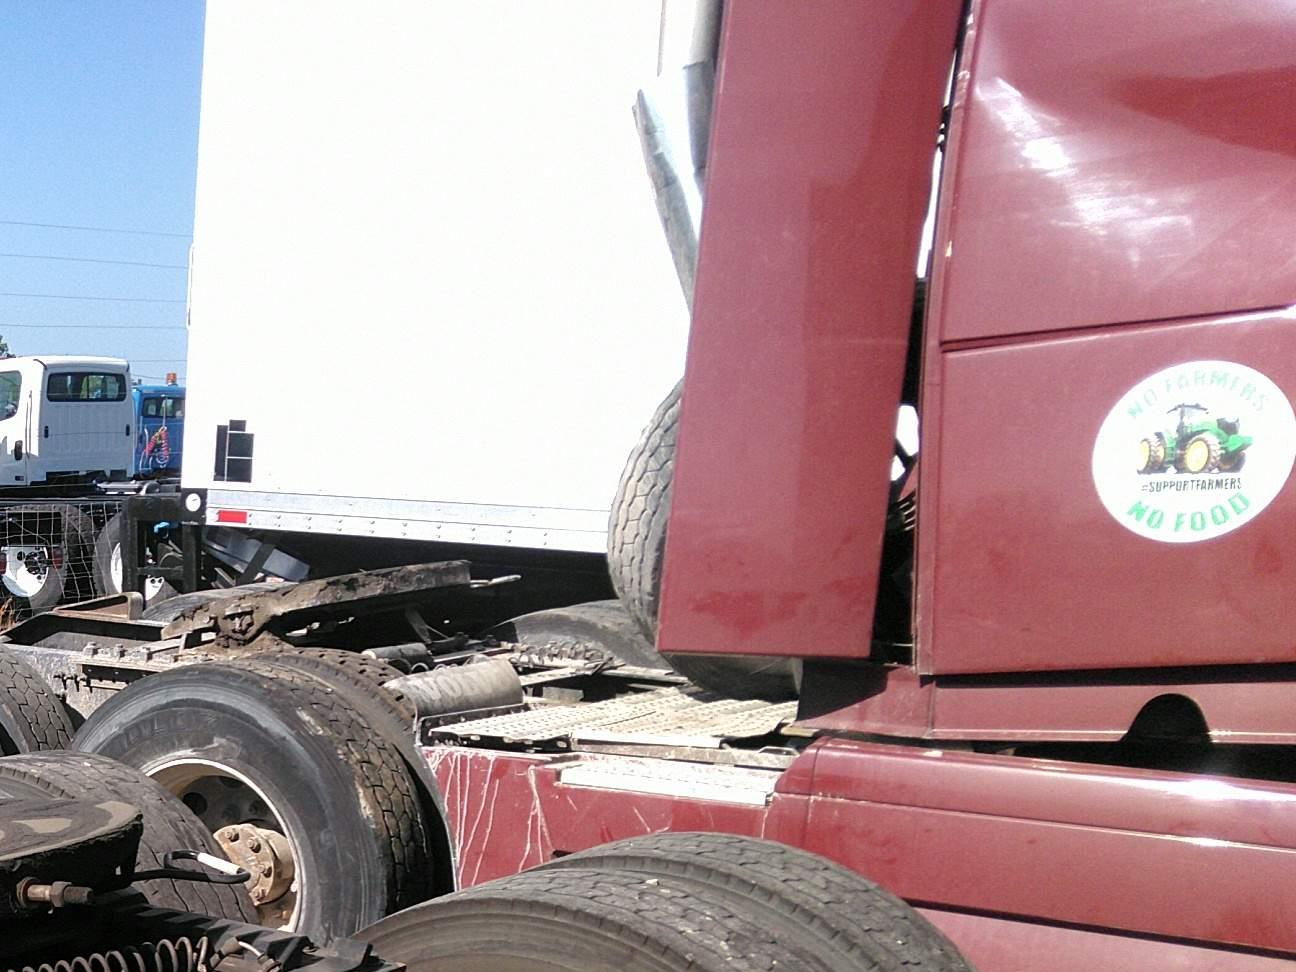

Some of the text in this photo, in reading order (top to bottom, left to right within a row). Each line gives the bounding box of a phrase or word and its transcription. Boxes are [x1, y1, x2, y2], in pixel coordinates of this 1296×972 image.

[1127, 369, 1269, 419] NO FARMERS
[1126, 492, 1251, 533] NO FOOD
